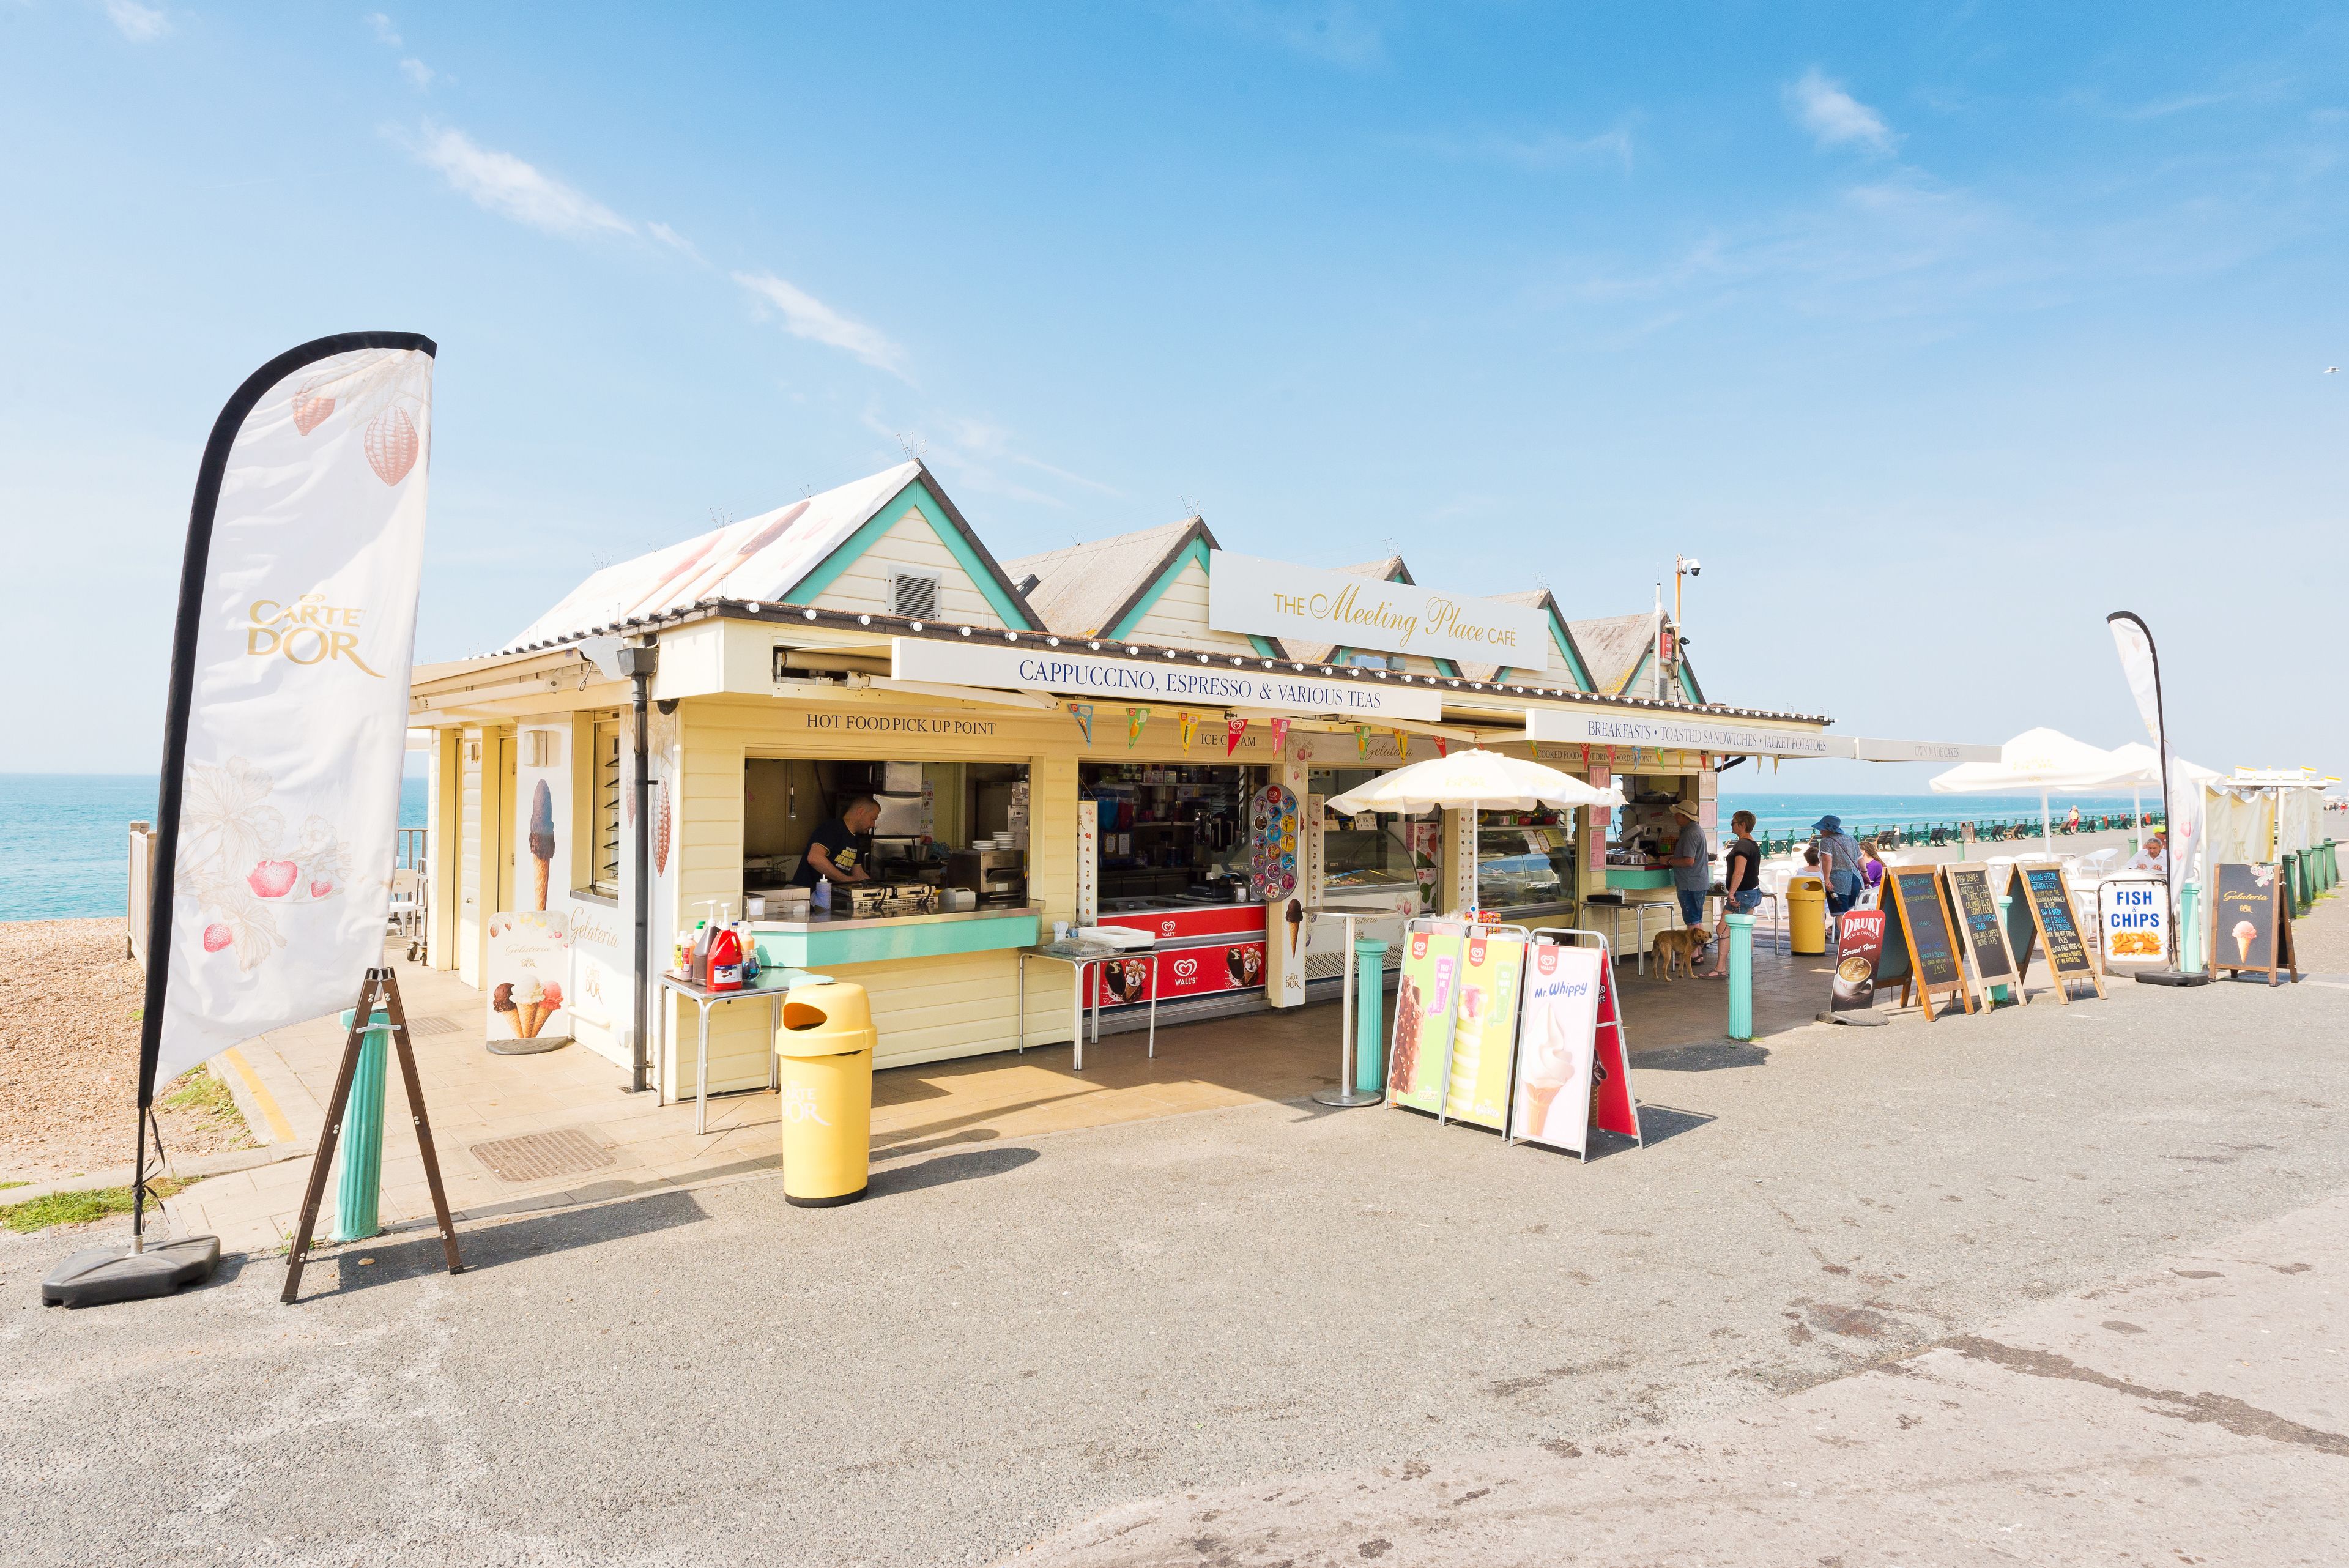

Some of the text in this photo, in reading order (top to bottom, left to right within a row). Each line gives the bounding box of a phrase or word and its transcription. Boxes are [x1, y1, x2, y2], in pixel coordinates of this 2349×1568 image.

[249, 599, 362, 630] CARTE
[1273, 583, 1516, 647] THE Meeting Place CAFÉ
[247, 624, 387, 678] D'OR
[1020, 660, 1381, 709] CAPPUCCINO, ESPRESSO & VARIOUS TEAS
[806, 713, 996, 735] HOT FOOD PICK UP POINT
[1201, 734, 1256, 746] ICE CAM
[1588, 721, 1827, 751] BREAKFASTS TOASTED SANDWICHES JACKET POTATOES
[1365, 739, 1413, 761] Gelatea
[1537, 750, 1562, 759] COOKED
[1564, 751, 1579, 760] FOOD
[1619, 754, 1633, 762] ORDE
[1914, 746, 1959, 757] OWN MADE CAKES
[1966, 873, 1980, 882] DISHES
[2117, 891, 2152, 905] FISH
[2223, 890, 2269, 902] Gelateria
[570, 906, 619, 948] Gelateria
[2110, 913, 2159, 927] CHIPS
[1843, 918, 1883, 940] DRURY
[1846, 932, 1857, 941] TEAS
[1860, 931, 1876, 940] COFFEES
[505, 943, 551, 957] Gelateria
[1842, 946, 1861, 957] Served
[586, 966, 601, 980] CARTE
[1174, 977, 1196, 986] WALL'S
[1285, 980, 1301, 989] D'OR
[586, 979, 603, 1005] D'OR
[1535, 987, 1548, 998] Mr.
[1549, 981, 1588, 998] Whippy
